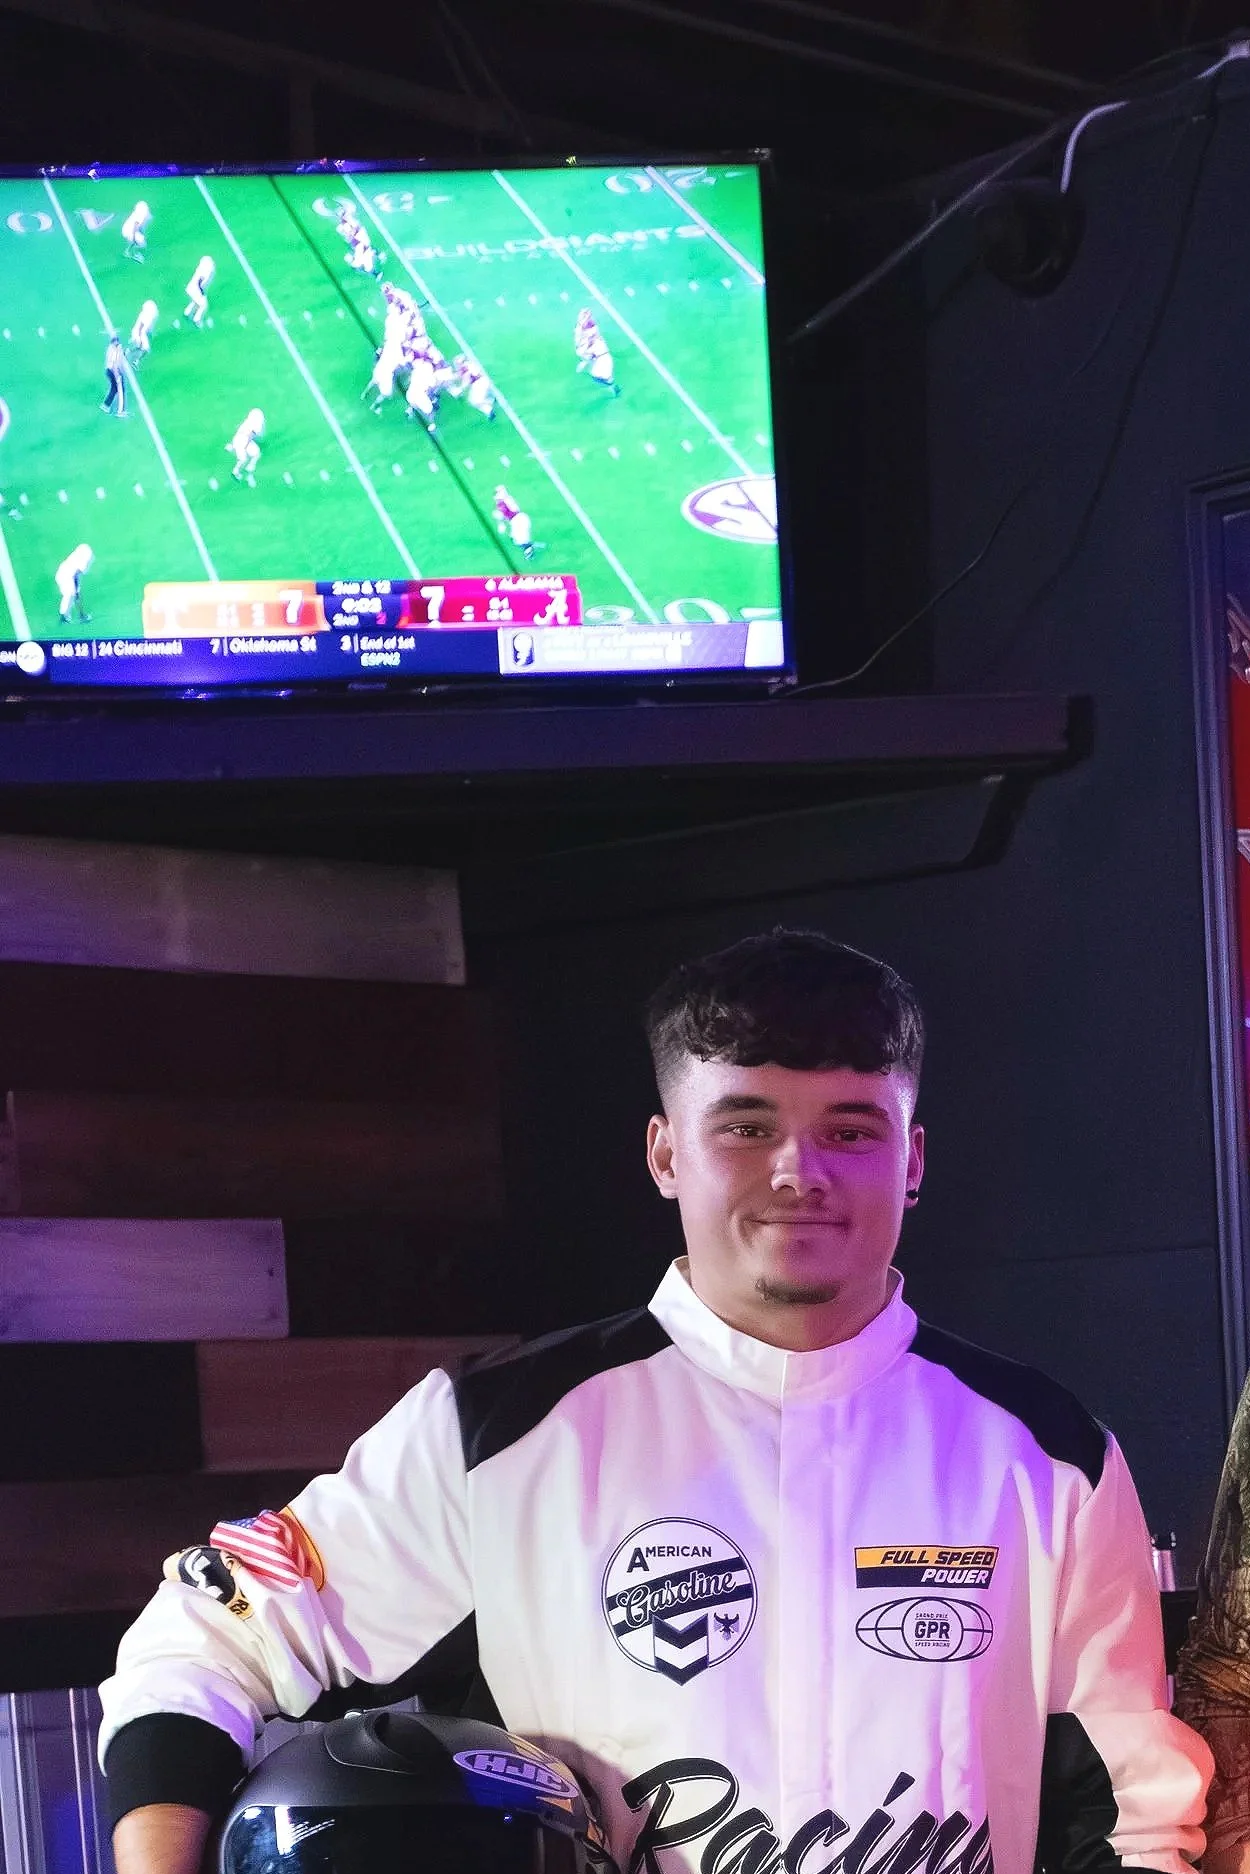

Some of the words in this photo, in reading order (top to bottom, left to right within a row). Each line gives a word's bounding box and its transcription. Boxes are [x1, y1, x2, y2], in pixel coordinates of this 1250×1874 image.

[279, 589, 304, 624] 7
[420, 585, 444, 621] 7
[113, 639, 183, 656] Cincinnati
[209, 637, 220, 655] 7
[229, 637, 299, 653] Oklahoma
[300, 635, 317, 651] St
[361, 651, 401, 666] ESPN2
[626, 1545, 712, 1574] AMERICAN
[880, 1550, 929, 1565] FULL
[934, 1550, 995, 1566] SPEED
[921, 1568, 989, 1584] POWER
[616, 1570, 737, 1628] Gasoline
[914, 1620, 950, 1639] GPR
[473, 1753, 566, 1792] HJC
